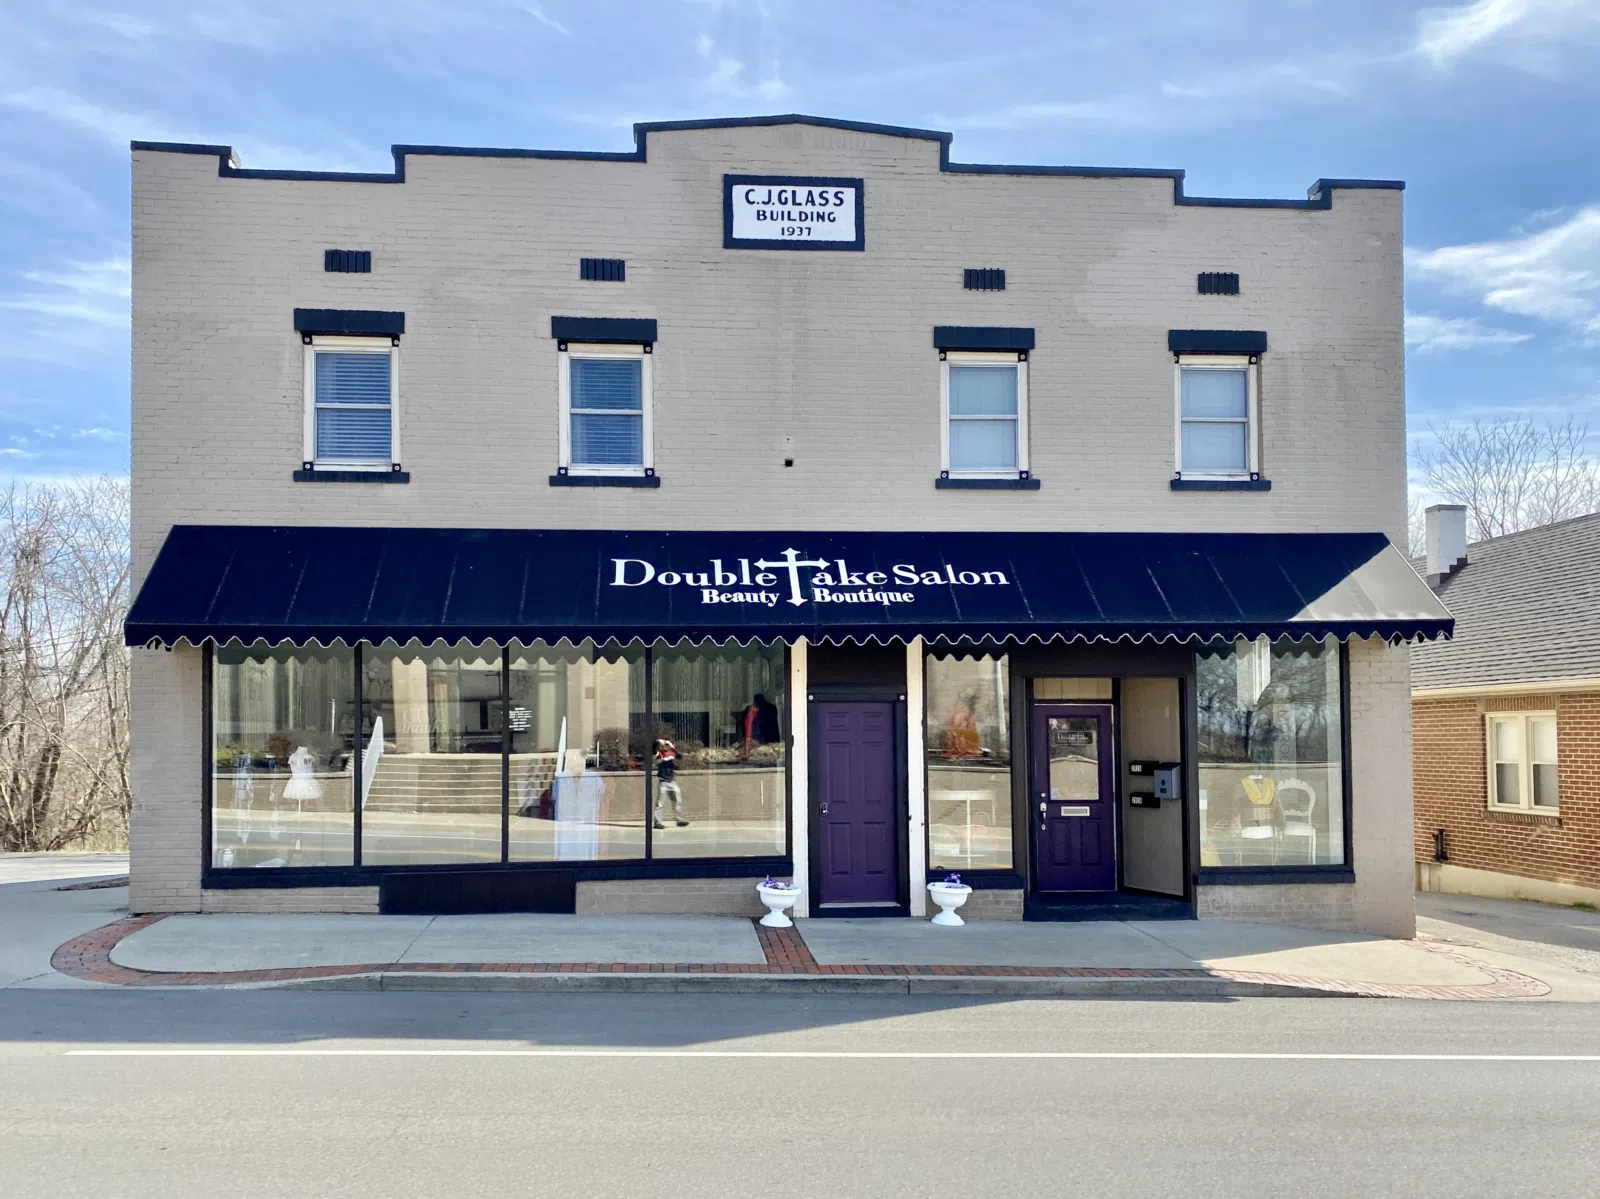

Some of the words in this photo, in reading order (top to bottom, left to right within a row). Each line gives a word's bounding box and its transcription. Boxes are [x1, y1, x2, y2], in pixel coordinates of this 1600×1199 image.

[756, 209, 837, 223] BUILDING
[781, 226, 812, 237] 1937
[893, 563, 1010, 587] Salon
[700, 588, 780, 608] Beauty
[812, 587, 915, 606] Boutique
